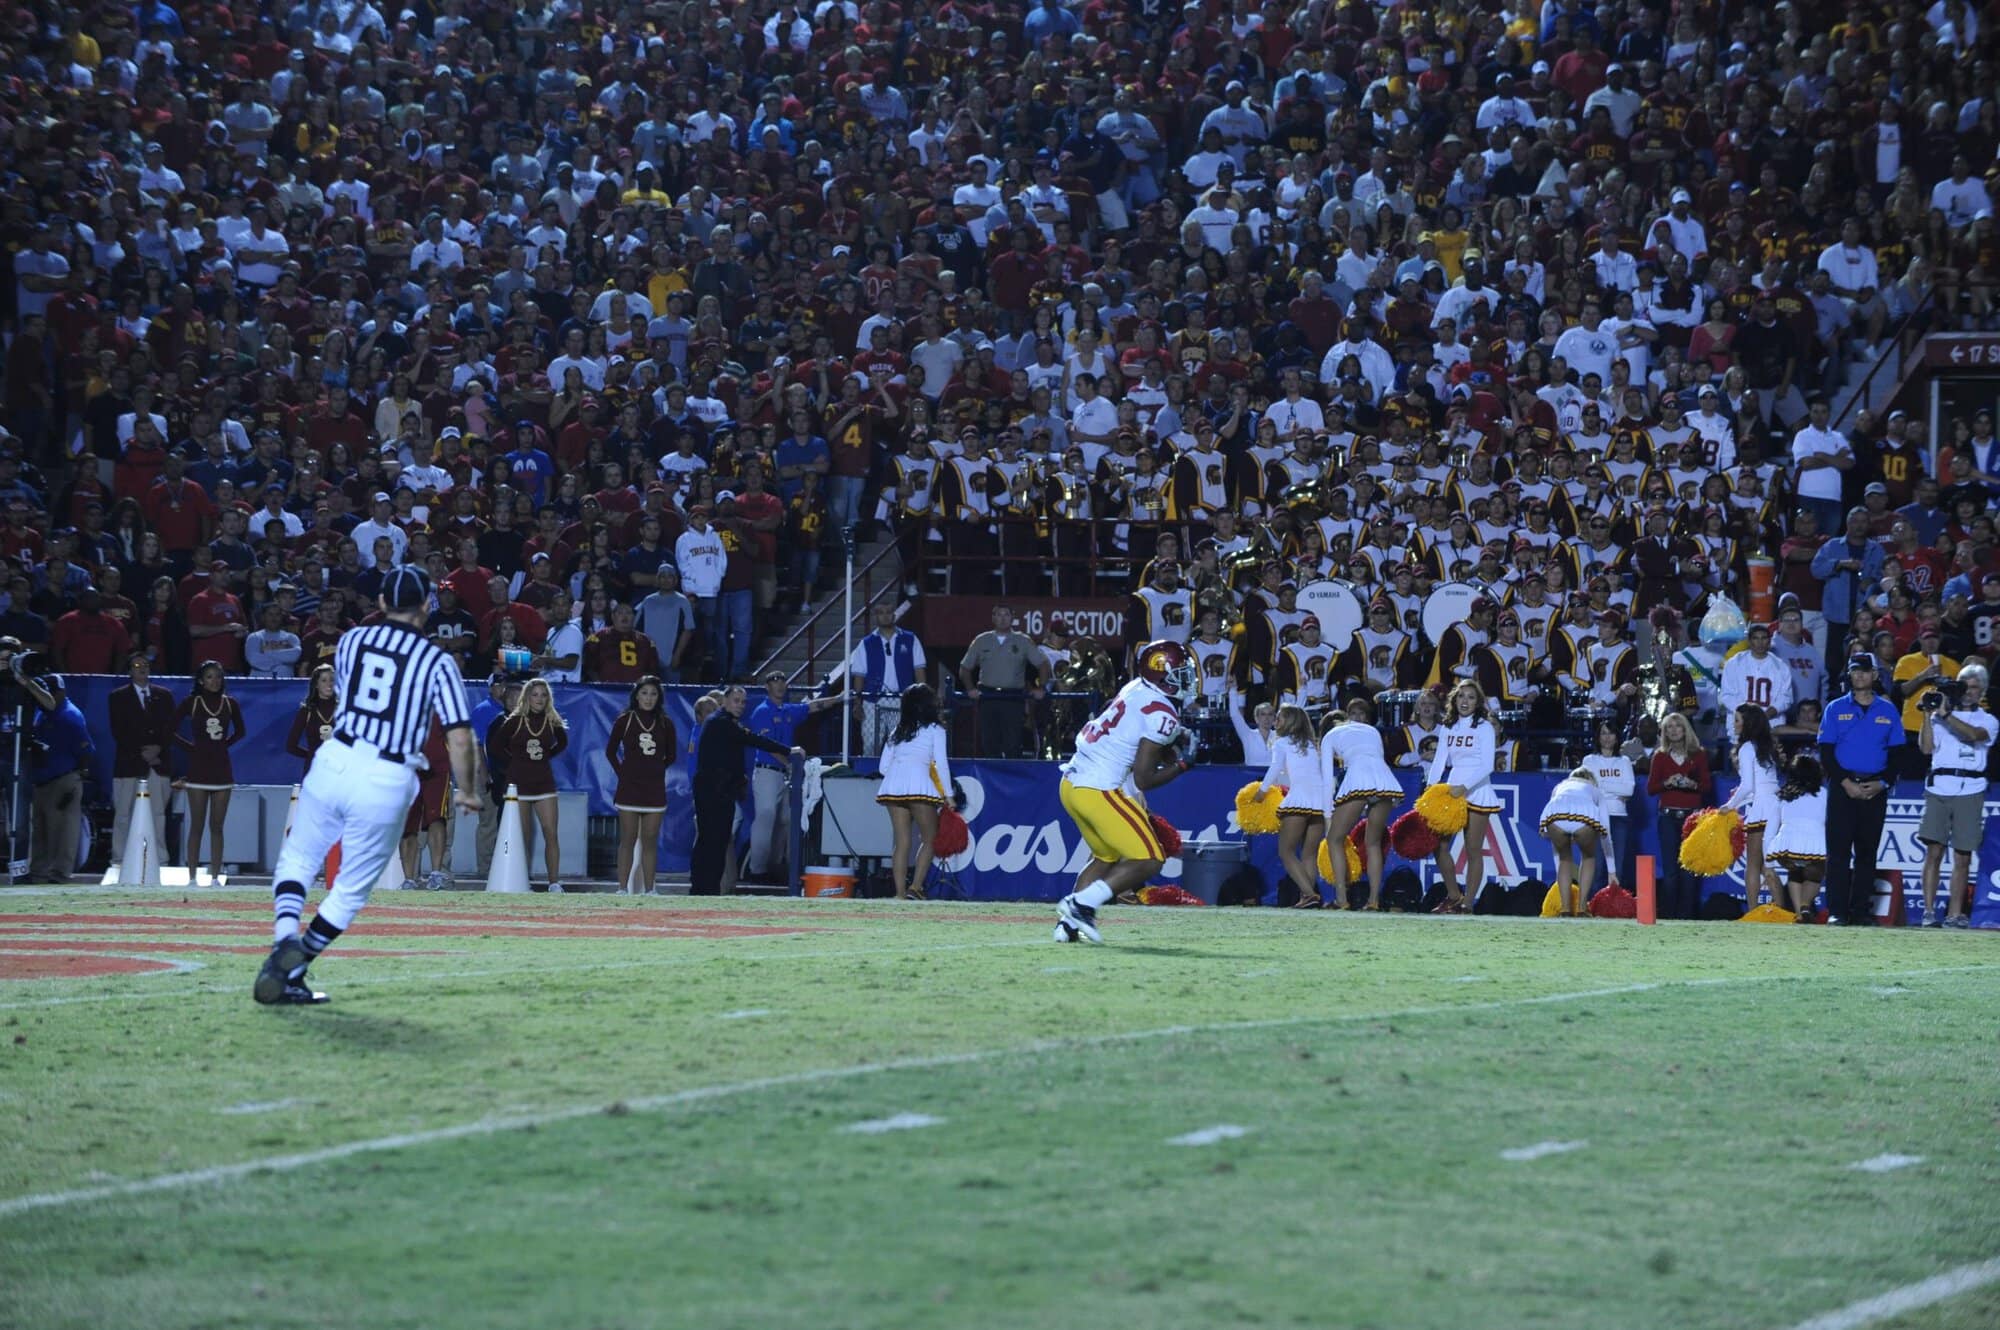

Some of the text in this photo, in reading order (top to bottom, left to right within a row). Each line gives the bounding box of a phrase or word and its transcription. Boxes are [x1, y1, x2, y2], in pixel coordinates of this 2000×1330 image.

[1968, 345, 1983, 363] 17
[843, 421, 863, 448] 4
[1882, 453, 1907, 481] 10
[1316, 591, 1340, 599] YAMAHA
[1024, 611, 1043, 636] 16
[619, 640, 637, 667] 6
[353, 652, 398, 713] B
[1745, 676, 1772, 707] 10
[1157, 716, 1176, 737] 13
[1447, 735, 1474, 748] USC
